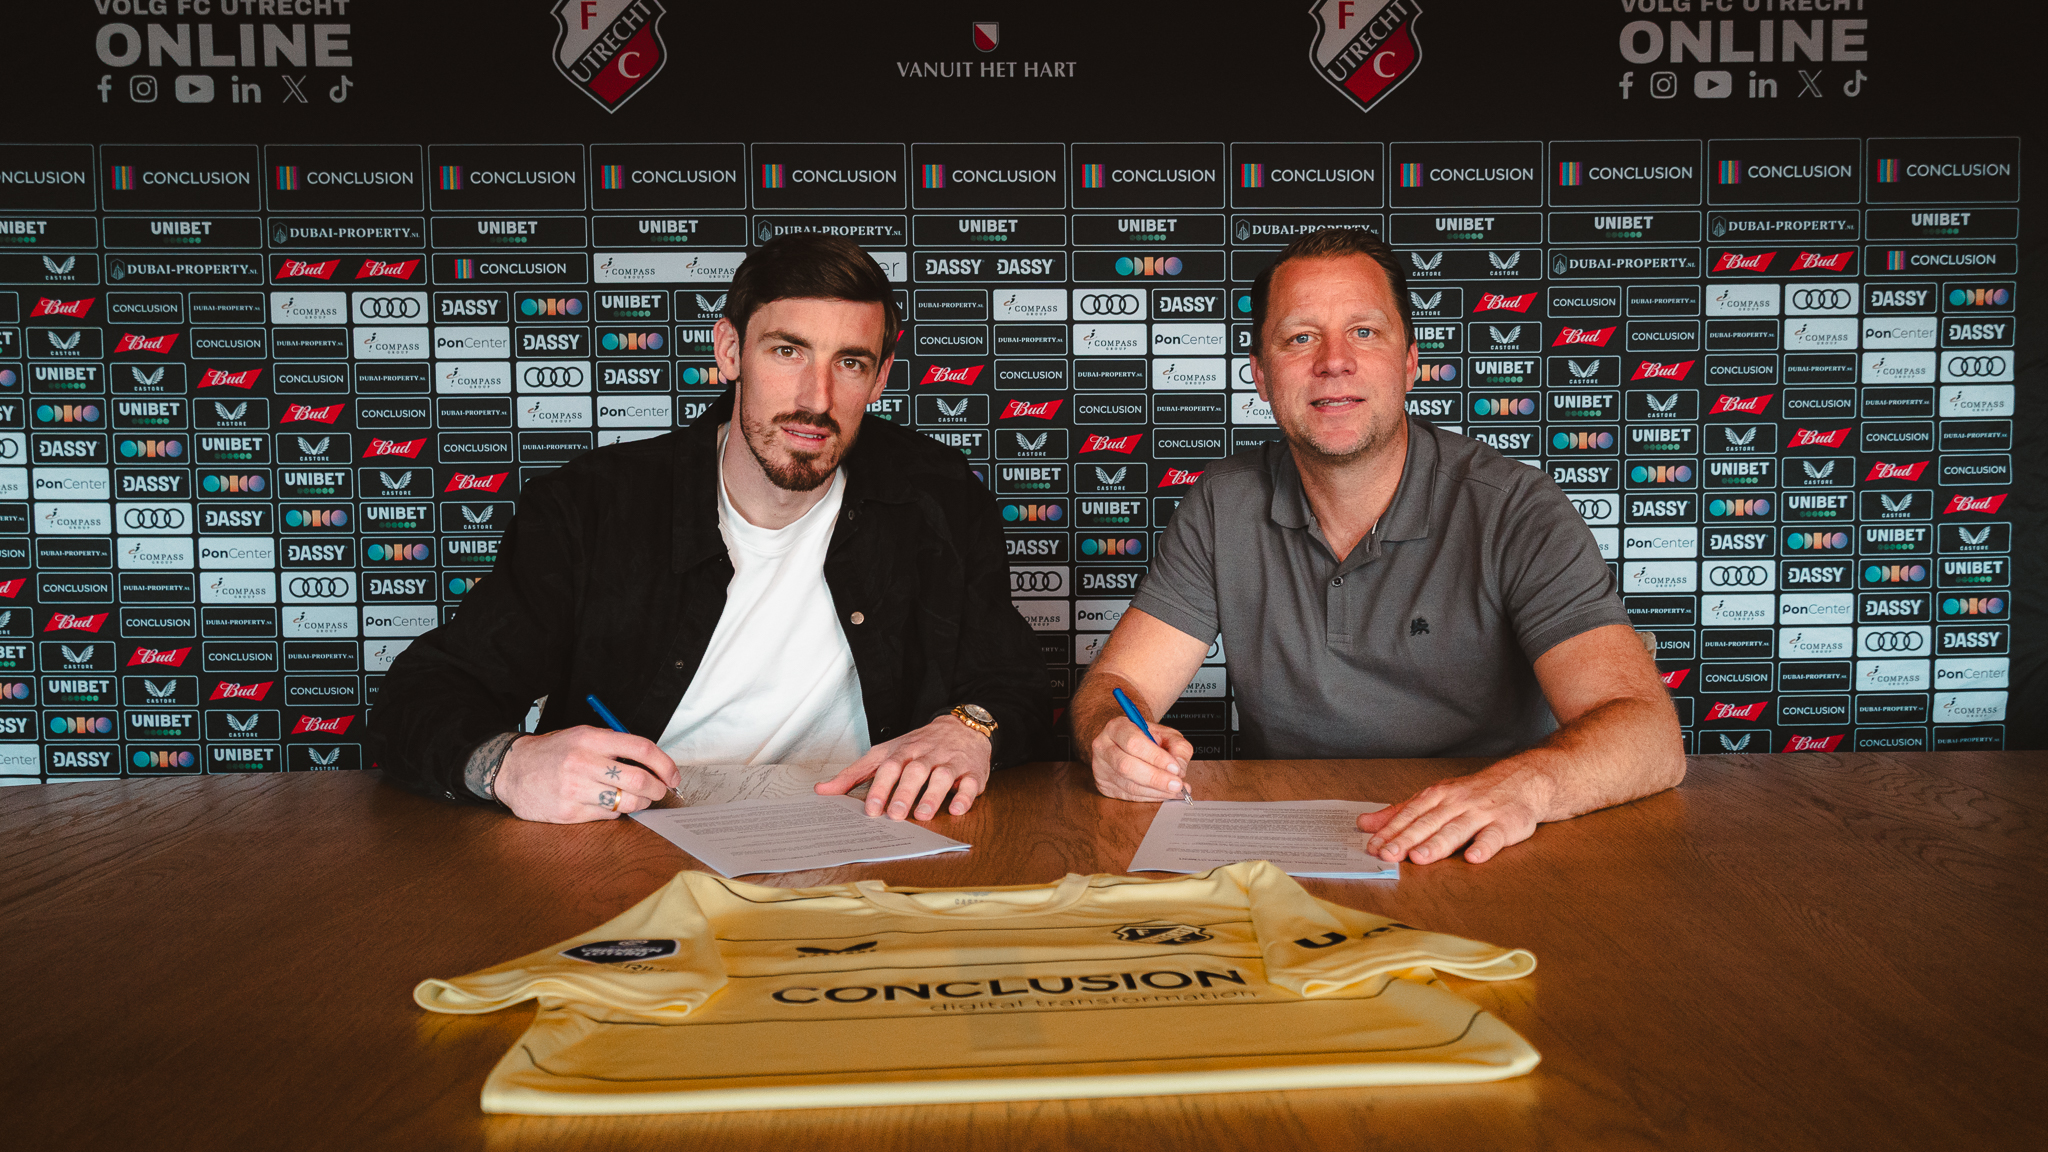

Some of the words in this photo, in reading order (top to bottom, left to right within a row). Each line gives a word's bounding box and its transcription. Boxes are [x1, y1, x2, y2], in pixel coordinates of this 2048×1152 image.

[95, 0, 167, 15] VOLG
[178, 0, 211, 15] FC
[221, 0, 350, 15] UTRECHT
[1621, 0, 1691, 12] VOLG
[1700, 0, 1733, 12] FC
[1743, 0, 1864, 11] UTRECHT
[581, 1, 597, 30] F
[1338, 1, 1355, 29] F
[96, 23, 352, 67] ONLINE
[571, 0, 652, 82] UTRECHT
[1327, 0, 1408, 82] UTRECHT
[1619, 19, 1868, 64] ONLINE
[618, 51, 640, 79] C
[896, 62, 973, 77] VANUIT
[982, 62, 1016, 77] HET
[1025, 61, 1077, 77] HART
[1373, 51, 1396, 78] C
[632, 170, 736, 183] CONCLUSION
[792, 170, 896, 182] CONCLUSION
[952, 170, 1055, 182] CONCLUSION
[1112, 170, 1215, 182] CONCLUSION
[1271, 170, 1374, 182] CONCLUSION
[1430, 168, 1533, 181] CONCLUSION
[1589, 167, 1692, 179] CONCLUSION
[1748, 165, 1851, 178] CONCLUSION
[1907, 164, 2010, 176] CONCLUSION
[0, 171, 85, 184] NCLUSION
[143, 172, 249, 184] CONCLUSION
[307, 172, 413, 184] CONCLUSION
[470, 171, 575, 184] CONCLUSION
[959, 220, 1018, 232] UNIBET
[1118, 219, 1177, 232] UNIBET
[1436, 218, 1494, 231] UNIBET
[1595, 216, 1653, 229] UNIBET
[1912, 213, 1970, 226] UNIBET
[0, 221, 47, 234] NIBET
[151, 222, 212, 235] UNIBET
[478, 221, 537, 234] UNIBET
[639, 220, 698, 233] UNIBET
[926, 259, 981, 274] DASSY
[997, 259, 1052, 274] DASSY
[1723, 254, 1761, 268] Bud
[1801, 253, 1838, 268] Bud
[1911, 255, 1995, 265] CONCLUSION
[287, 261, 325, 276] Bud
[366, 261, 404, 276] Bud
[480, 263, 566, 274] CONCLUSION
[602, 295, 661, 308] UNIBET
[1484, 295, 1522, 309] Bud
[1553, 298, 1615, 306] CONCLUSION
[1871, 290, 1927, 306] DASSY
[442, 300, 498, 315] DASSY
[1563, 329, 1601, 343] Bud
[1632, 332, 1694, 340] CONCLUSION
[1949, 324, 2005, 340] DASSY
[523, 334, 579, 350] DASSY
[931, 367, 968, 381] Bud
[1476, 361, 1534, 374] UNIBET
[1642, 363, 1679, 377] Bud
[1710, 366, 1773, 374] CONCLUSION
[1000, 371, 1062, 379] CONCLUSION
[1554, 395, 1612, 408] UNIBET
[1720, 396, 1758, 411] Bud
[1788, 400, 1851, 408] CONCLUSION
[119, 403, 180, 415] UNIBET
[291, 405, 329, 420] Bud
[362, 410, 425, 418] CONCLUSION
[1633, 429, 1691, 442] UNIBET
[1798, 430, 1836, 444] Bud
[1866, 433, 1928, 441] CONCLUSION
[40, 441, 97, 456] DASSY
[373, 440, 411, 454] Bud
[444, 444, 507, 452] CONCLUSION
[1003, 468, 1061, 480] UNIBET
[1711, 462, 1769, 475] UNIBET
[123, 476, 180, 491] DASSY
[285, 473, 345, 485] UNIBET
[455, 474, 493, 489] Bud
[1632, 501, 1690, 516] DASSY
[1789, 496, 1847, 509] UNIBET
[206, 511, 262, 526] DASSY
[367, 507, 426, 520] UNIBET
[1867, 528, 1925, 542] UNIBET
[288, 545, 345, 560] DASSY
[1945, 561, 2003, 574] UNIBET
[370, 579, 426, 594] DASSY
[1083, 574, 1138, 588] DASSY
[43, 584, 107, 592] CONCLUSION
[1866, 600, 1923, 615] DASSY
[55, 614, 94, 629] Bud
[126, 619, 190, 627] CONCLUSION
[1706, 674, 1767, 682] CONCLUSION
[220, 683, 258, 697] Bud
[291, 687, 353, 695] CONCLUSION
[1715, 704, 1752, 717] Bud
[1954, 707, 1997, 717] COMPASS
[132, 715, 192, 727] UNIBET
[1792, 736, 1829, 750] Bud
[1860, 739, 1922, 747] CONCLUSION
[53, 752, 110, 767] DASSY
[214, 749, 273, 761] UNIBET
[772, 970, 1246, 1004] CONCLUSION
[930, 1000, 1023, 1012] digital
[1036, 990, 1257, 1008] transformation
